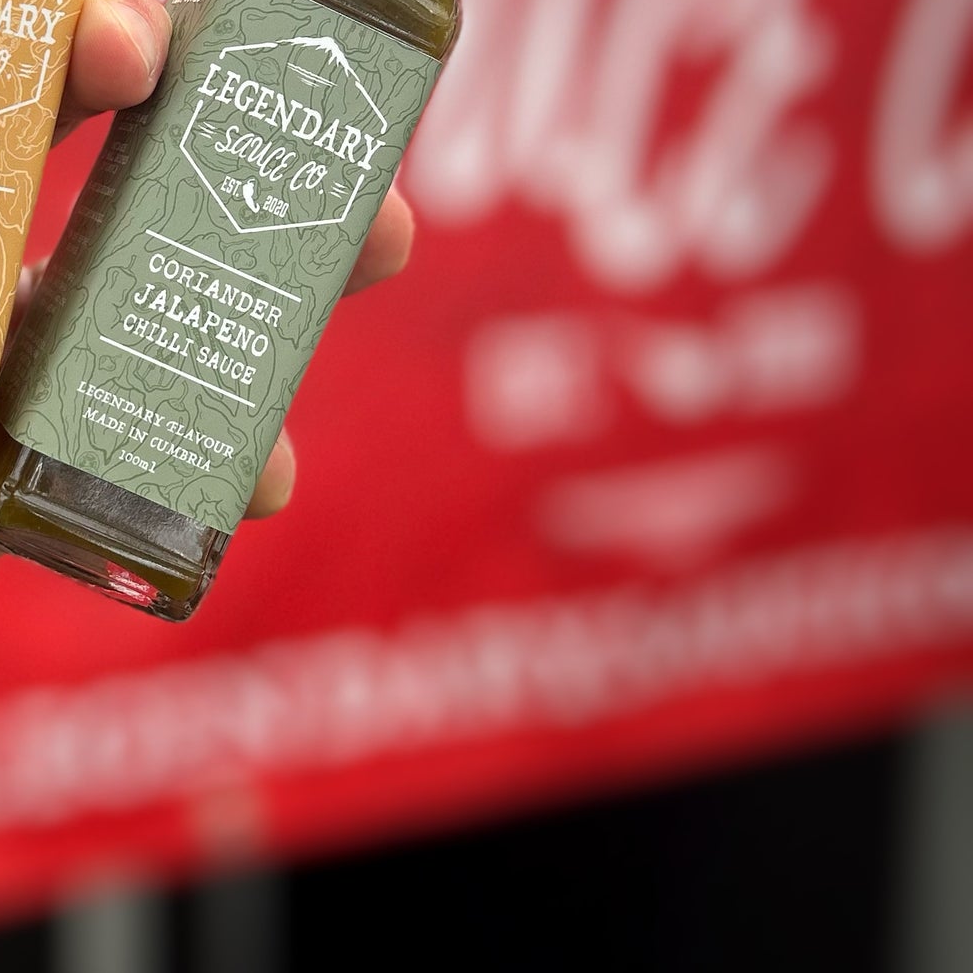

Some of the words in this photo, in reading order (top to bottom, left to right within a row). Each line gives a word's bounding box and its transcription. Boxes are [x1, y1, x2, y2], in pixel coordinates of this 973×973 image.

[197, 63, 387, 172] LEGENDARY
[219, 175, 243, 198] EST.
[262, 194, 291, 219] 2020
[133, 283, 270, 358] JALAPENO
[148, 253, 283, 328] CORIANDER
[123, 313, 195, 357] CHILLI
[196, 346, 257, 386] SAUCE
[76, 380, 166, 428] LEGENDARY
[165, 420, 235, 460] FLAVOUR
[82, 407, 128, 434] MADE
[127, 426, 150, 444] IN
[149, 436, 213, 473] CUMBRIA
[118, 449, 158, 475] 100ml
